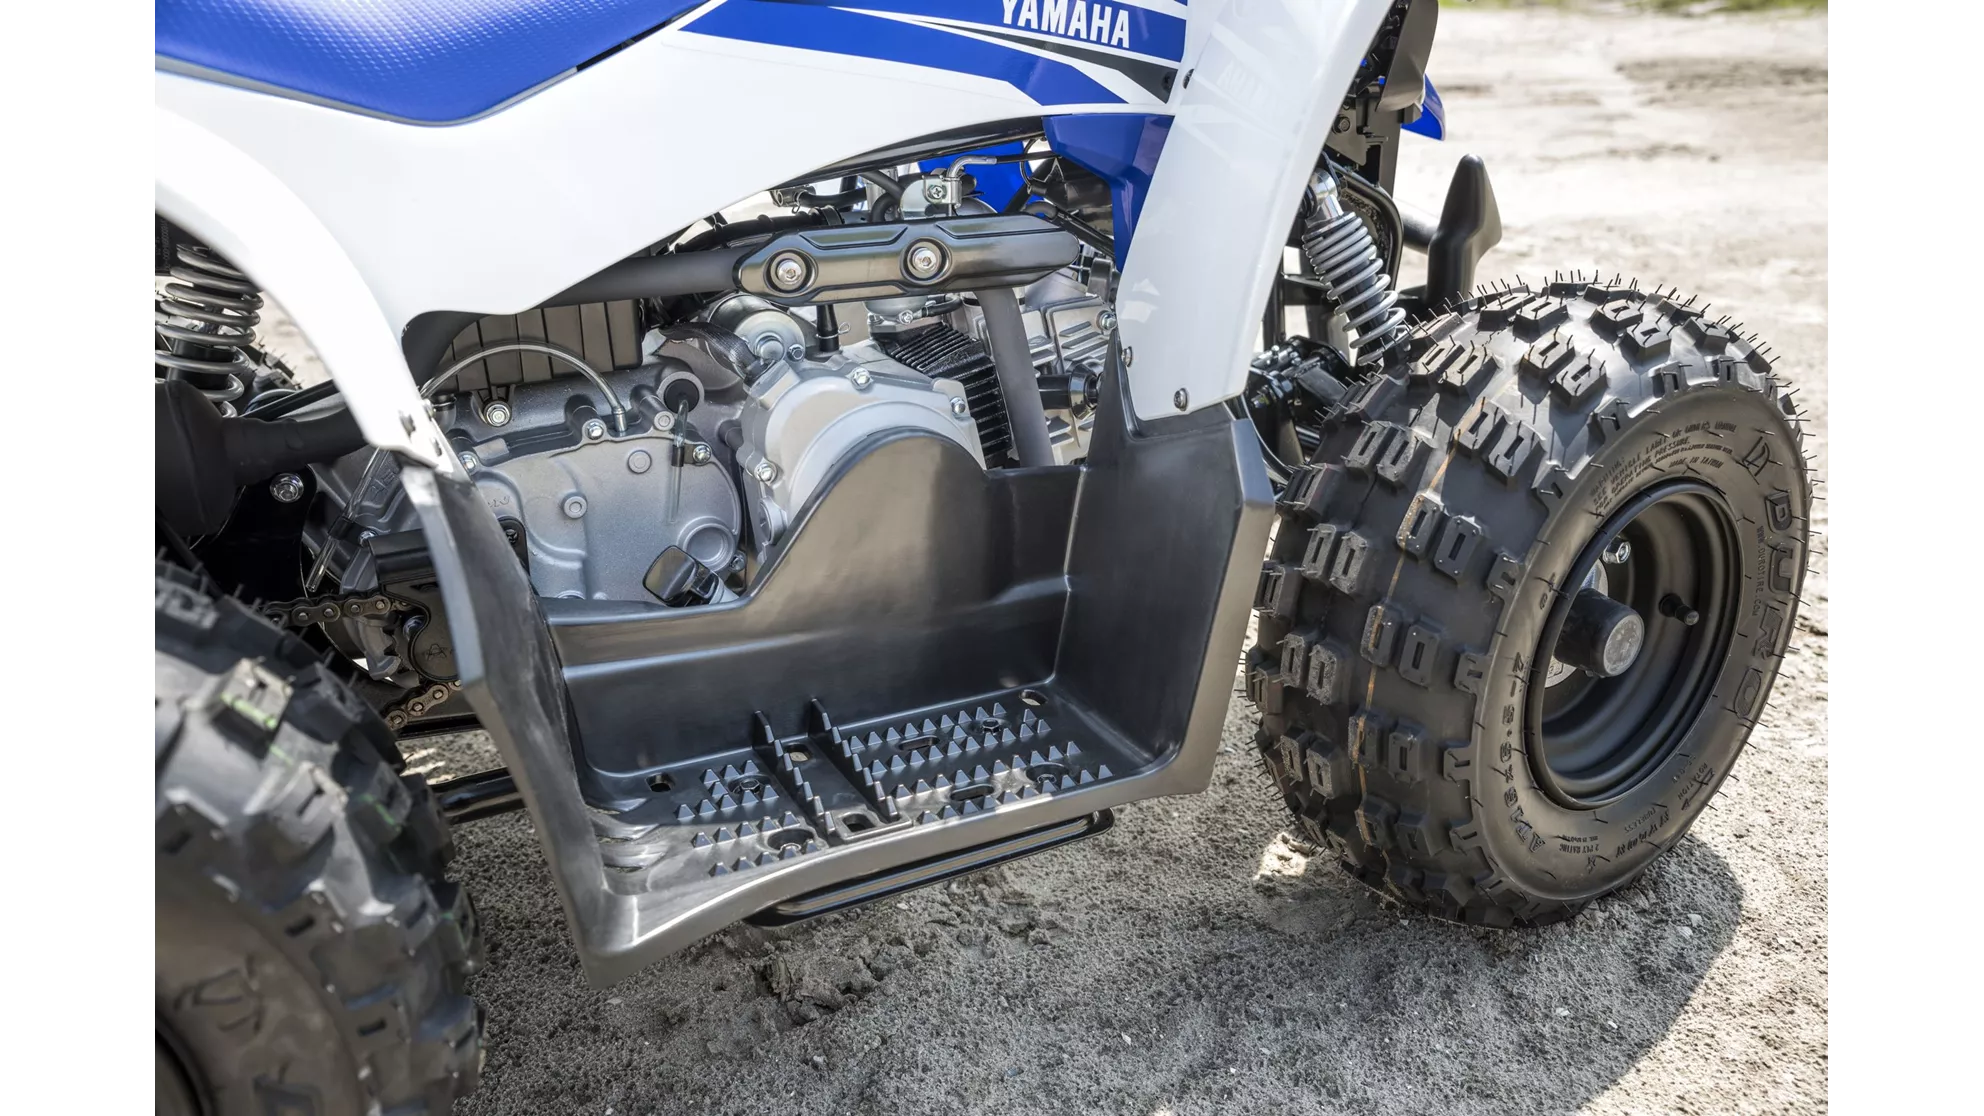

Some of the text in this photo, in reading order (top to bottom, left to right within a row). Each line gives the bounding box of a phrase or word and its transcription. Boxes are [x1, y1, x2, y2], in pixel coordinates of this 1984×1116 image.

[1001, 0, 1130, 49] YAMAHA
[1733, 490, 1793, 719] DURO
[1677, 762, 1708, 801] ROTATION
